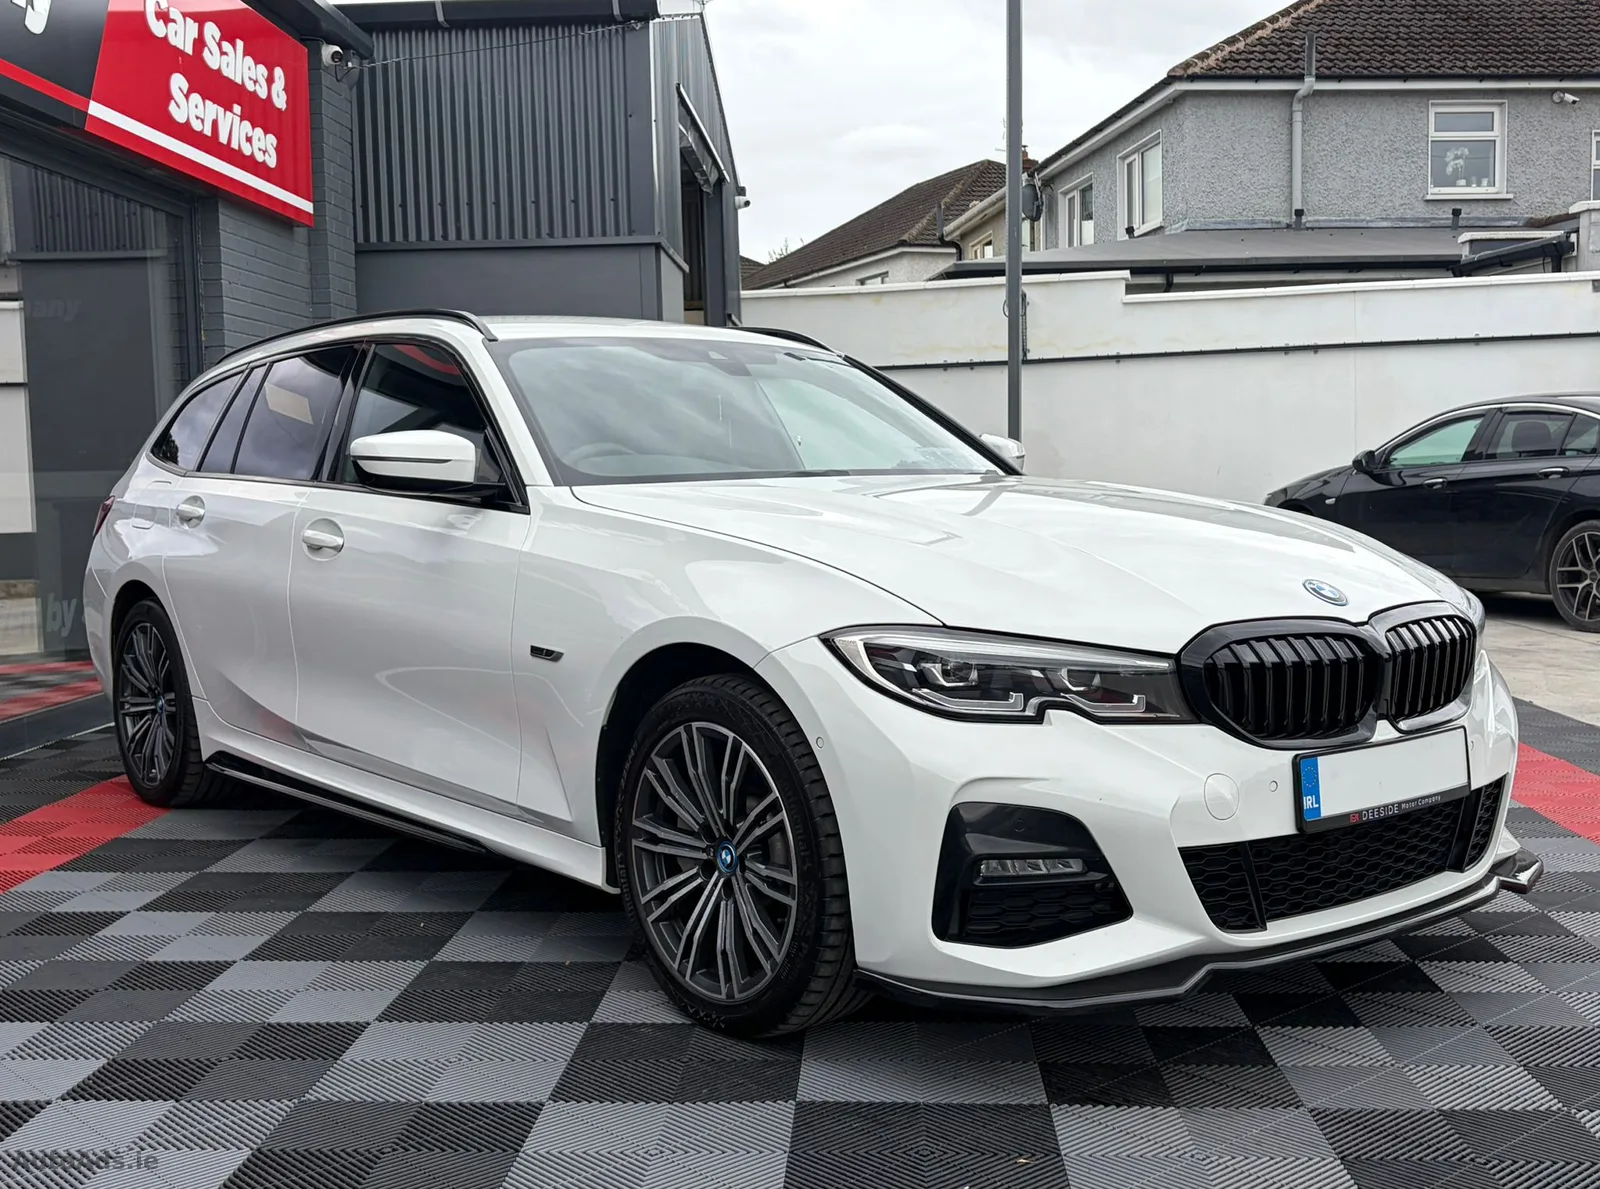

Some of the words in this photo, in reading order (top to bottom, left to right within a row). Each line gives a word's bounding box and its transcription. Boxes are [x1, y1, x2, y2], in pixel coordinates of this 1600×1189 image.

[145, 0, 199, 56] Car
[202, 21, 268, 100] Sales
[271, 66, 287, 112] &
[168, 72, 278, 169] Services
[46, 592, 77, 637] by
[1303, 795, 1319, 810] IRL
[1362, 803, 1399, 820] DEESIDE
[1401, 801, 1418, 810] Motor
[1418, 795, 1441, 806] Company
